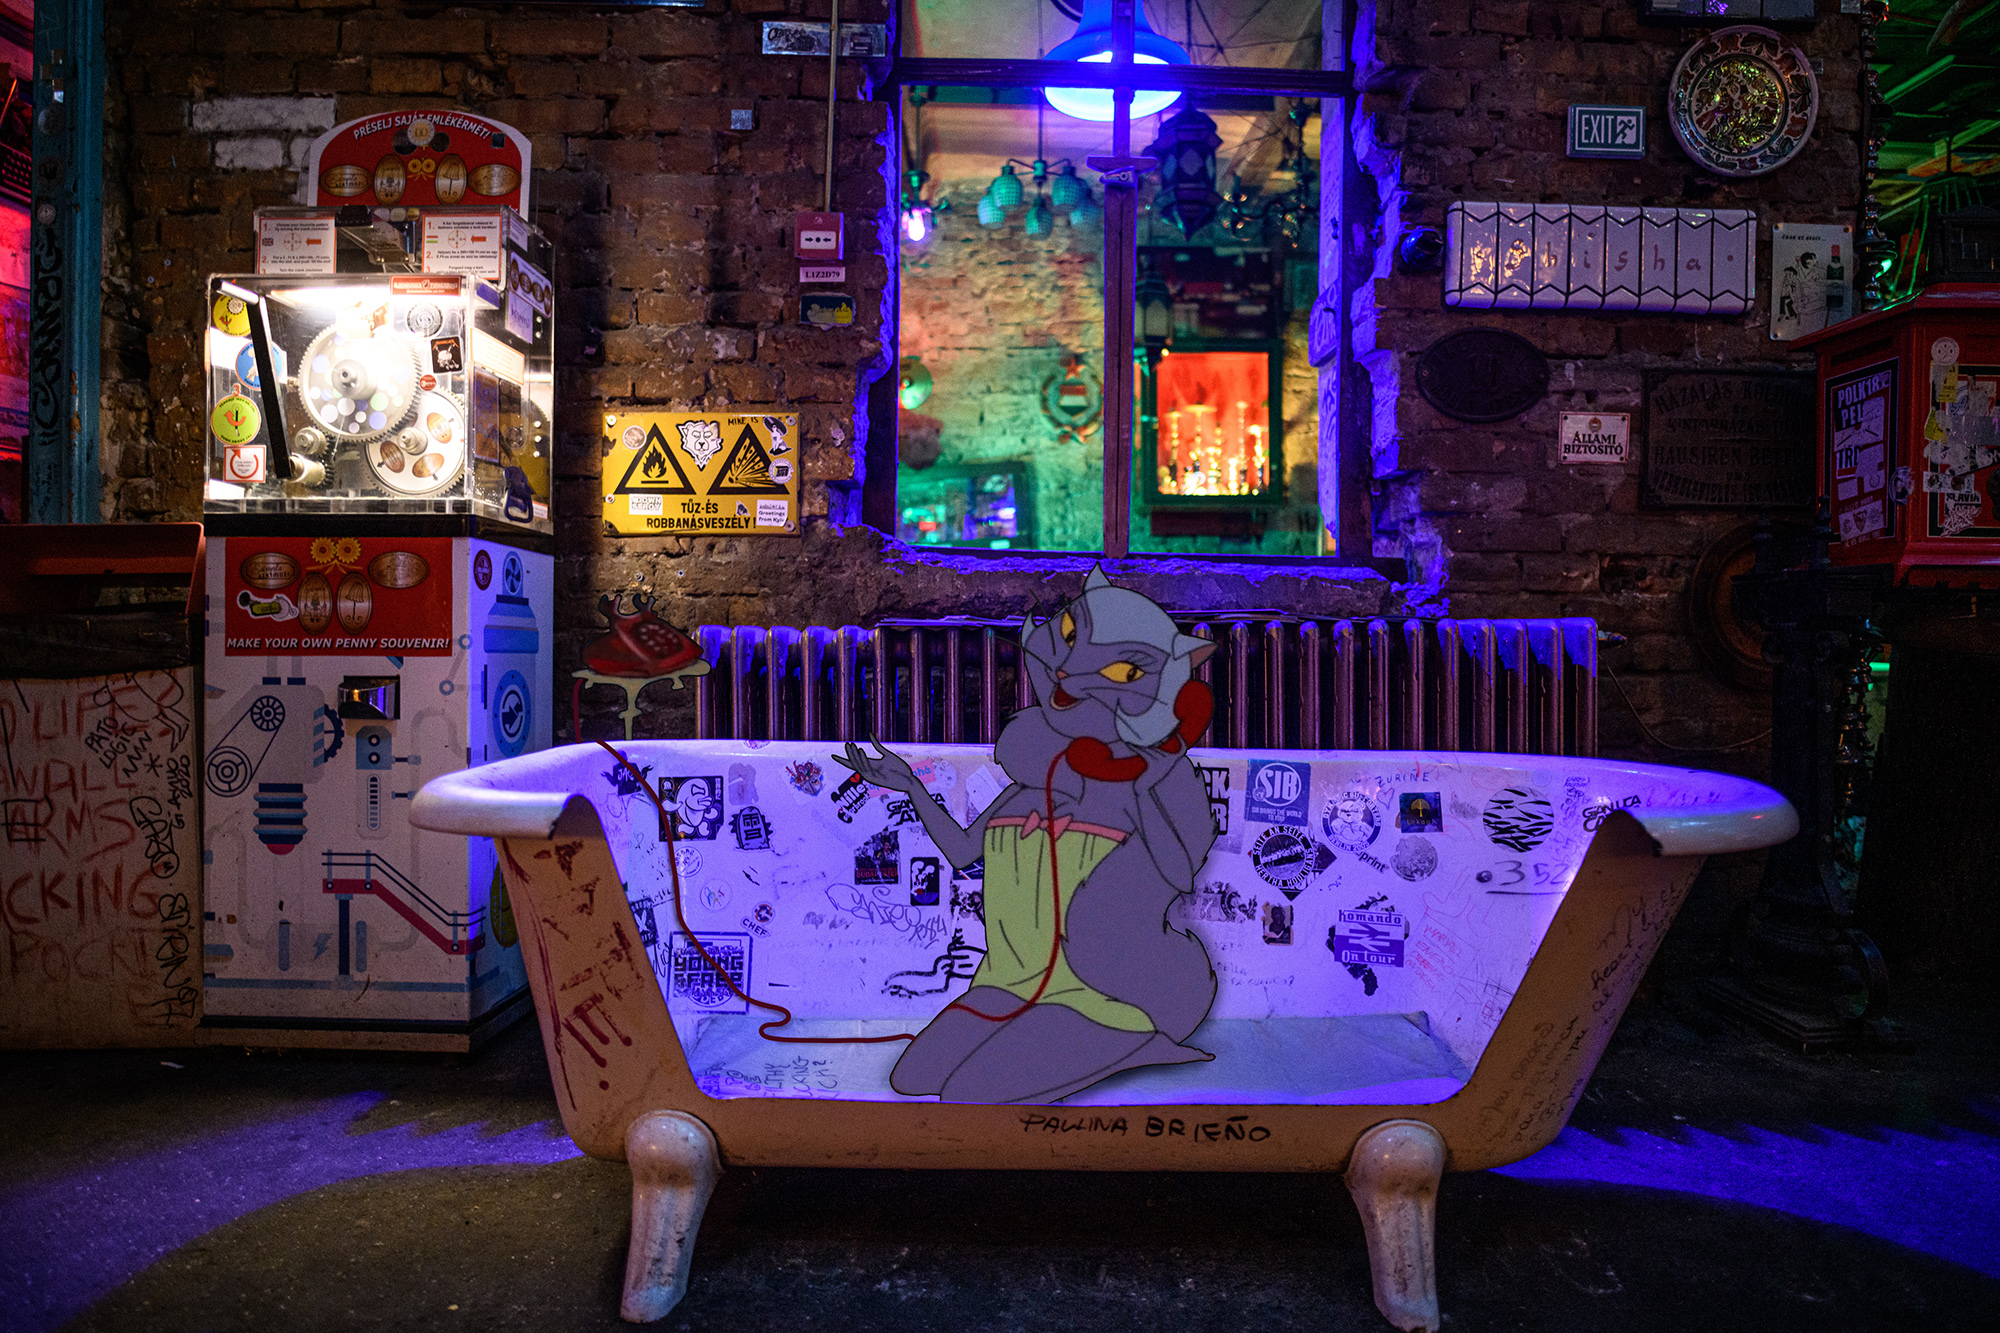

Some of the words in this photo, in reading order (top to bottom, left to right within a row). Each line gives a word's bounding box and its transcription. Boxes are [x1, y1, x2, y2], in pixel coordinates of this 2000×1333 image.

[1581, 114, 1614, 144] EXIT
[1572, 431, 1616, 444] ÁLLAMI
[681, 499, 719, 514] TŰZ-ÉS
[758, 510, 785, 518] Greetings
[646, 514, 749, 529] ROBBANÁSVESZÉLY
[226, 637, 261, 648] MAKE
[263, 637, 298, 648] YOUR
[301, 637, 332, 649] OWN
[335, 637, 377, 648] PENNY
[380, 637, 450, 649] SOUVENIR!
[1259, 768, 1298, 800] SIB
[1375, 769, 1430, 788] ZURIÑE
[1253, 832, 1268, 856] SEITE
[1268, 826, 1281, 835] AN
[1283, 825, 1305, 841] SEITE
[1254, 864, 1283, 887] HERTHA
[1286, 847, 1314, 887] HOOLIGANS
[1338, 909, 1402, 924] Komando
[741, 918, 768, 936] CHEF
[674, 956, 743, 971] YOUNG
[1341, 949, 1359, 963] On
[1364, 950, 1395, 964] tour
[1145, 1114, 1271, 1142] BRIEÑO
